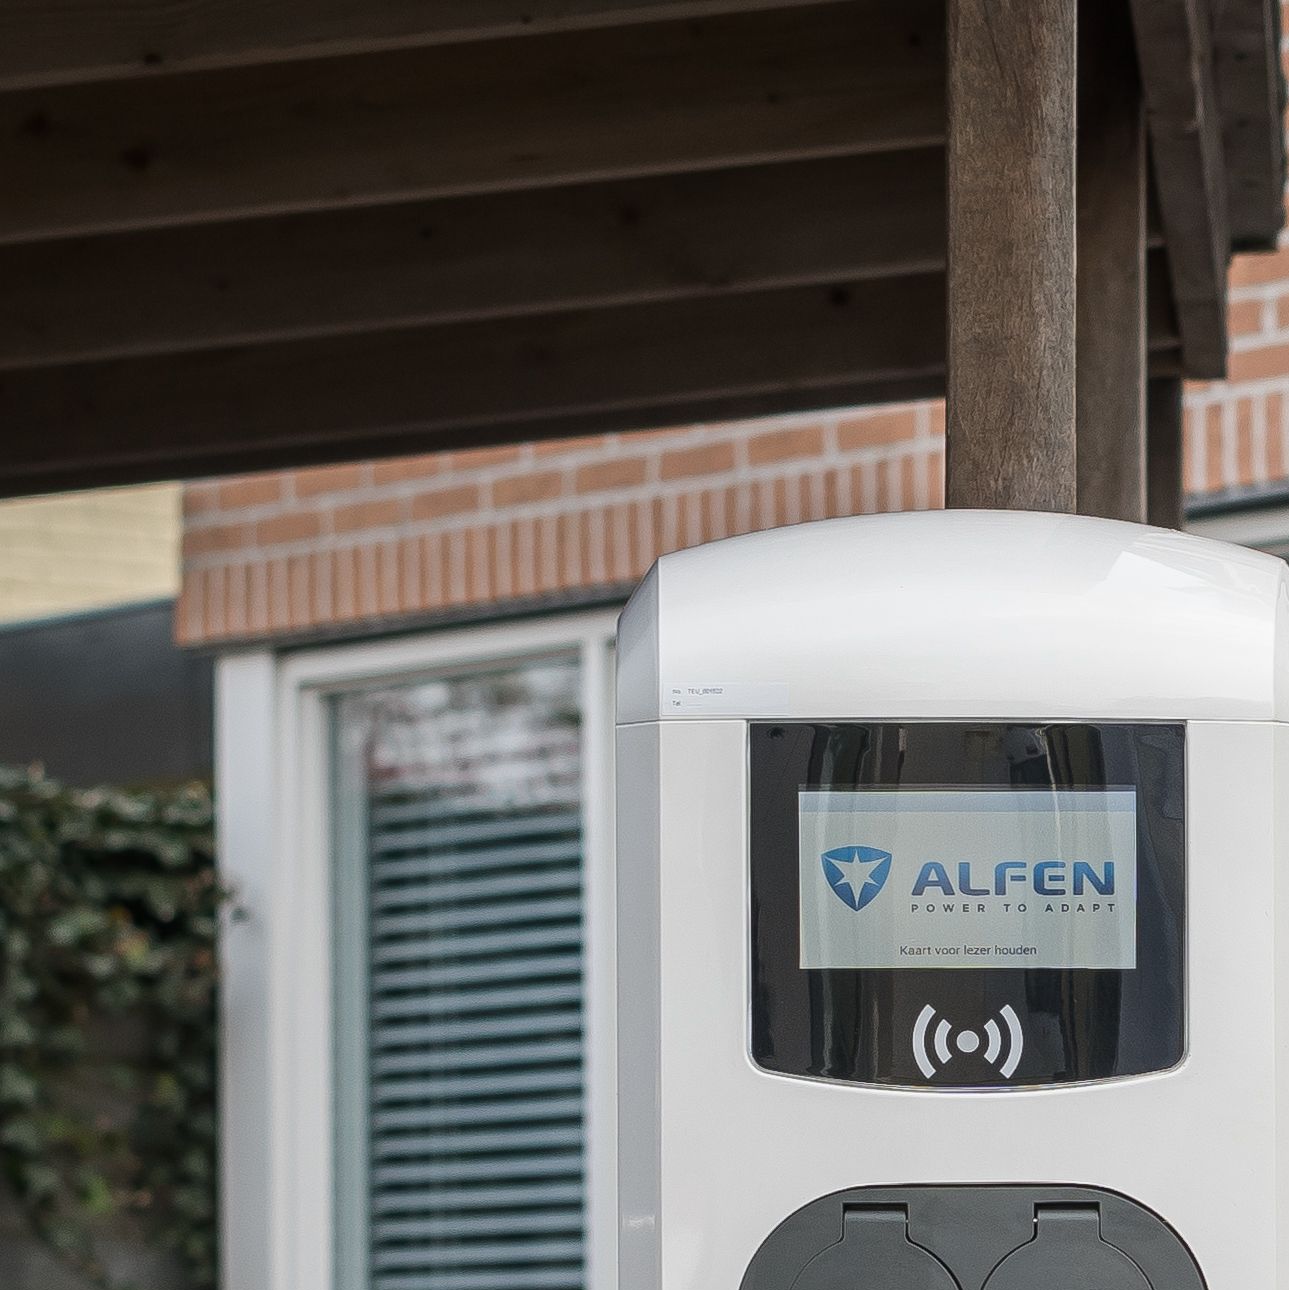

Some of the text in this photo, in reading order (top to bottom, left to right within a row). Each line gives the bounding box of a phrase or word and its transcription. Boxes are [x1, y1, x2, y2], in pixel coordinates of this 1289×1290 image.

[911, 861, 1115, 896] ALFEN
[911, 903, 1116, 913] POWER TO ADAPT
[900, 945, 1038, 956] Kaart voor lezer houden
